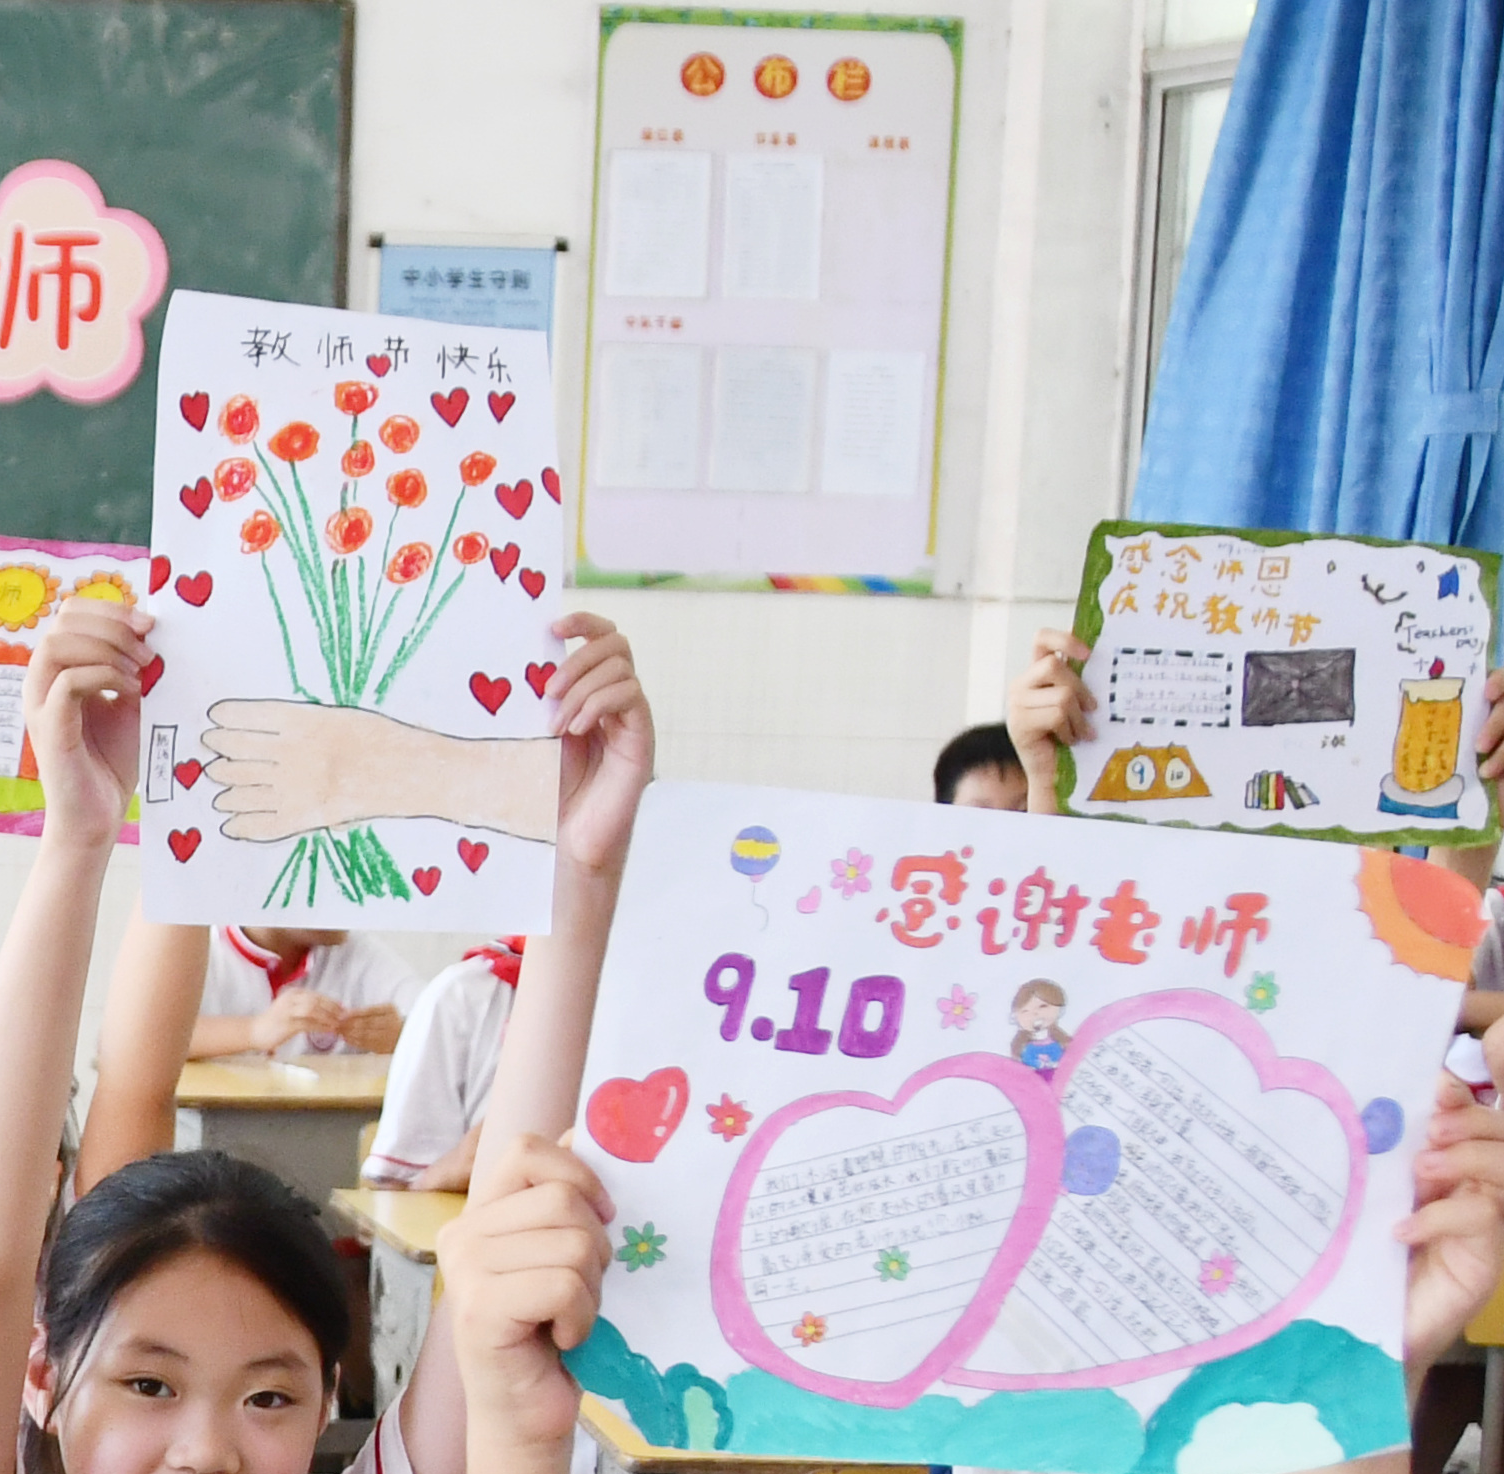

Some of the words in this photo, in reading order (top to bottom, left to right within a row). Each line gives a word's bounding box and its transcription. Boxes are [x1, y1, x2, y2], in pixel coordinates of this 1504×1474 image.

[683, 53, 869, 101] 公布栏
[1108, 581, 1322, 648] 庆祝教师节
[875, 845, 1270, 979] 感谢老师
[703, 951, 906, 1059] 9.10
